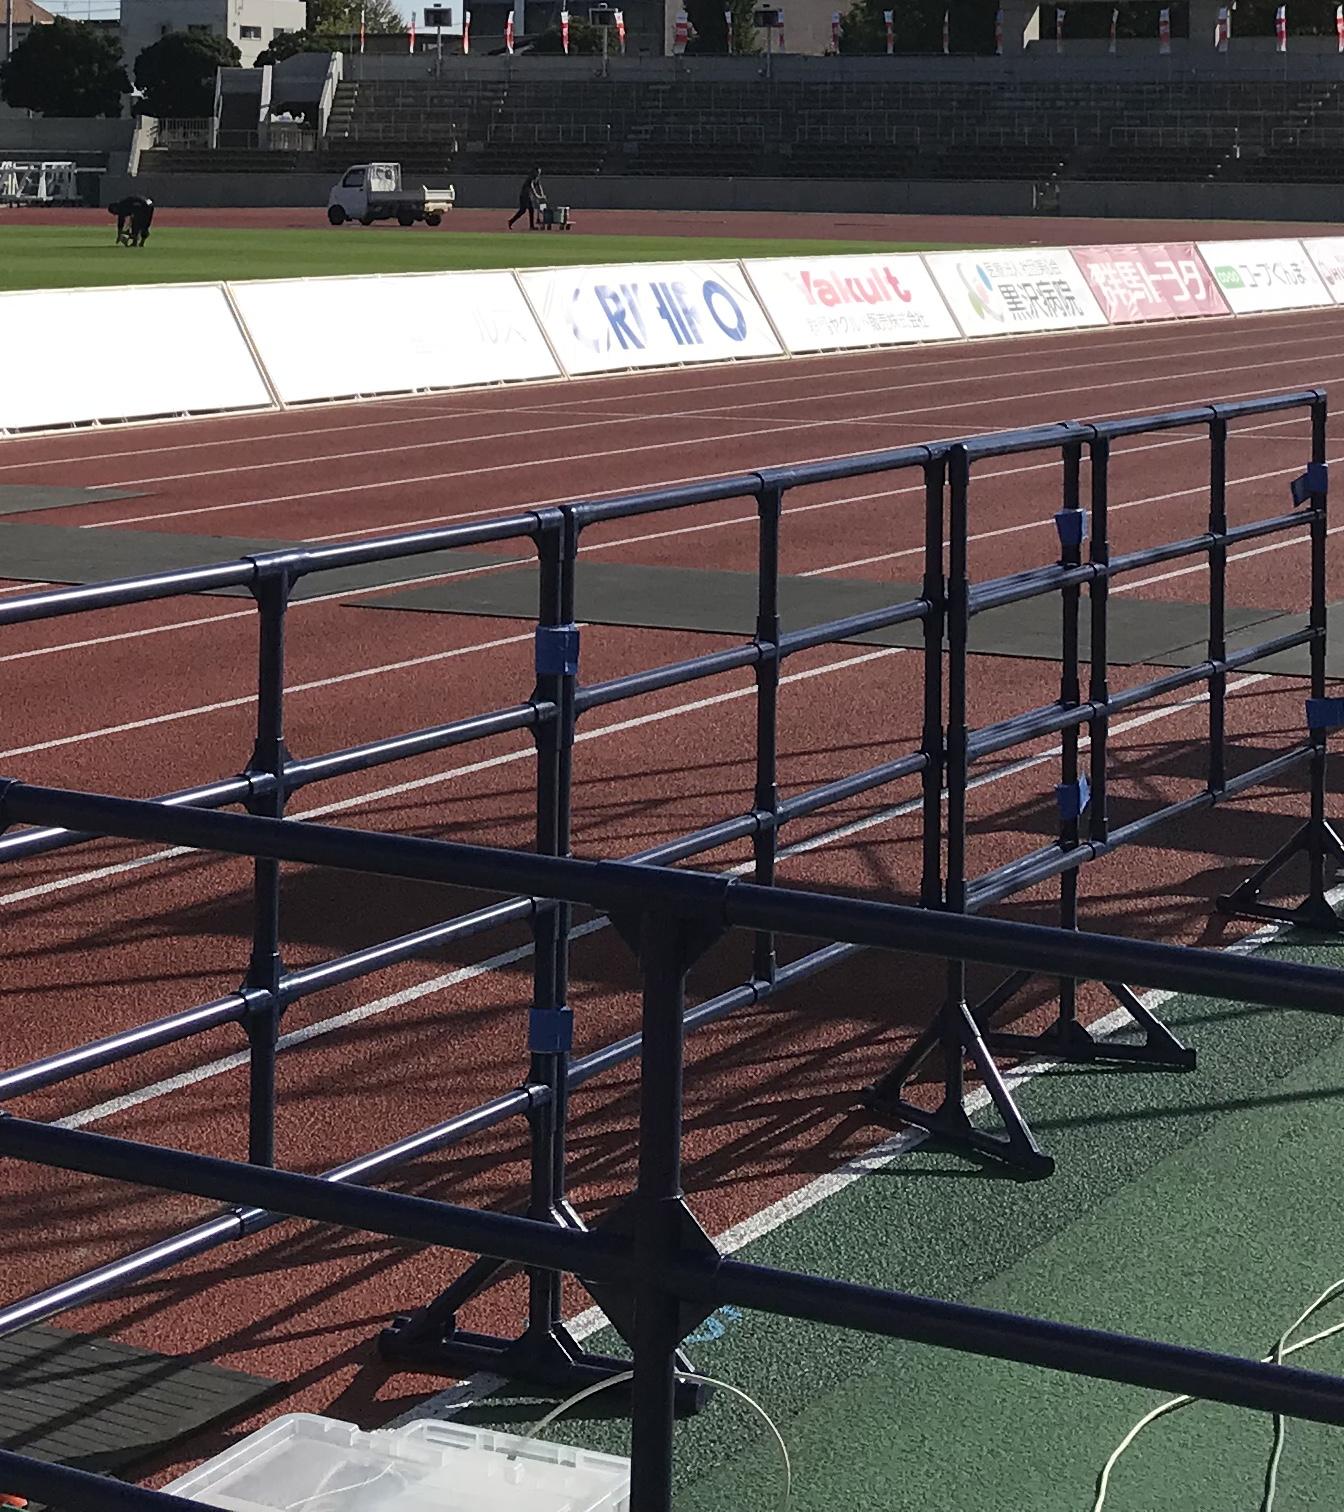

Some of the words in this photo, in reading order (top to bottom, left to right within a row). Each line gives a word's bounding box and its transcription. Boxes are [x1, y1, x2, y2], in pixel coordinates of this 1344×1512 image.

[784, 265, 913, 308] Yakult
[997, 278, 1085, 321] 黒沢病院
[1086, 259, 1207, 309] 群馬トヨタ
